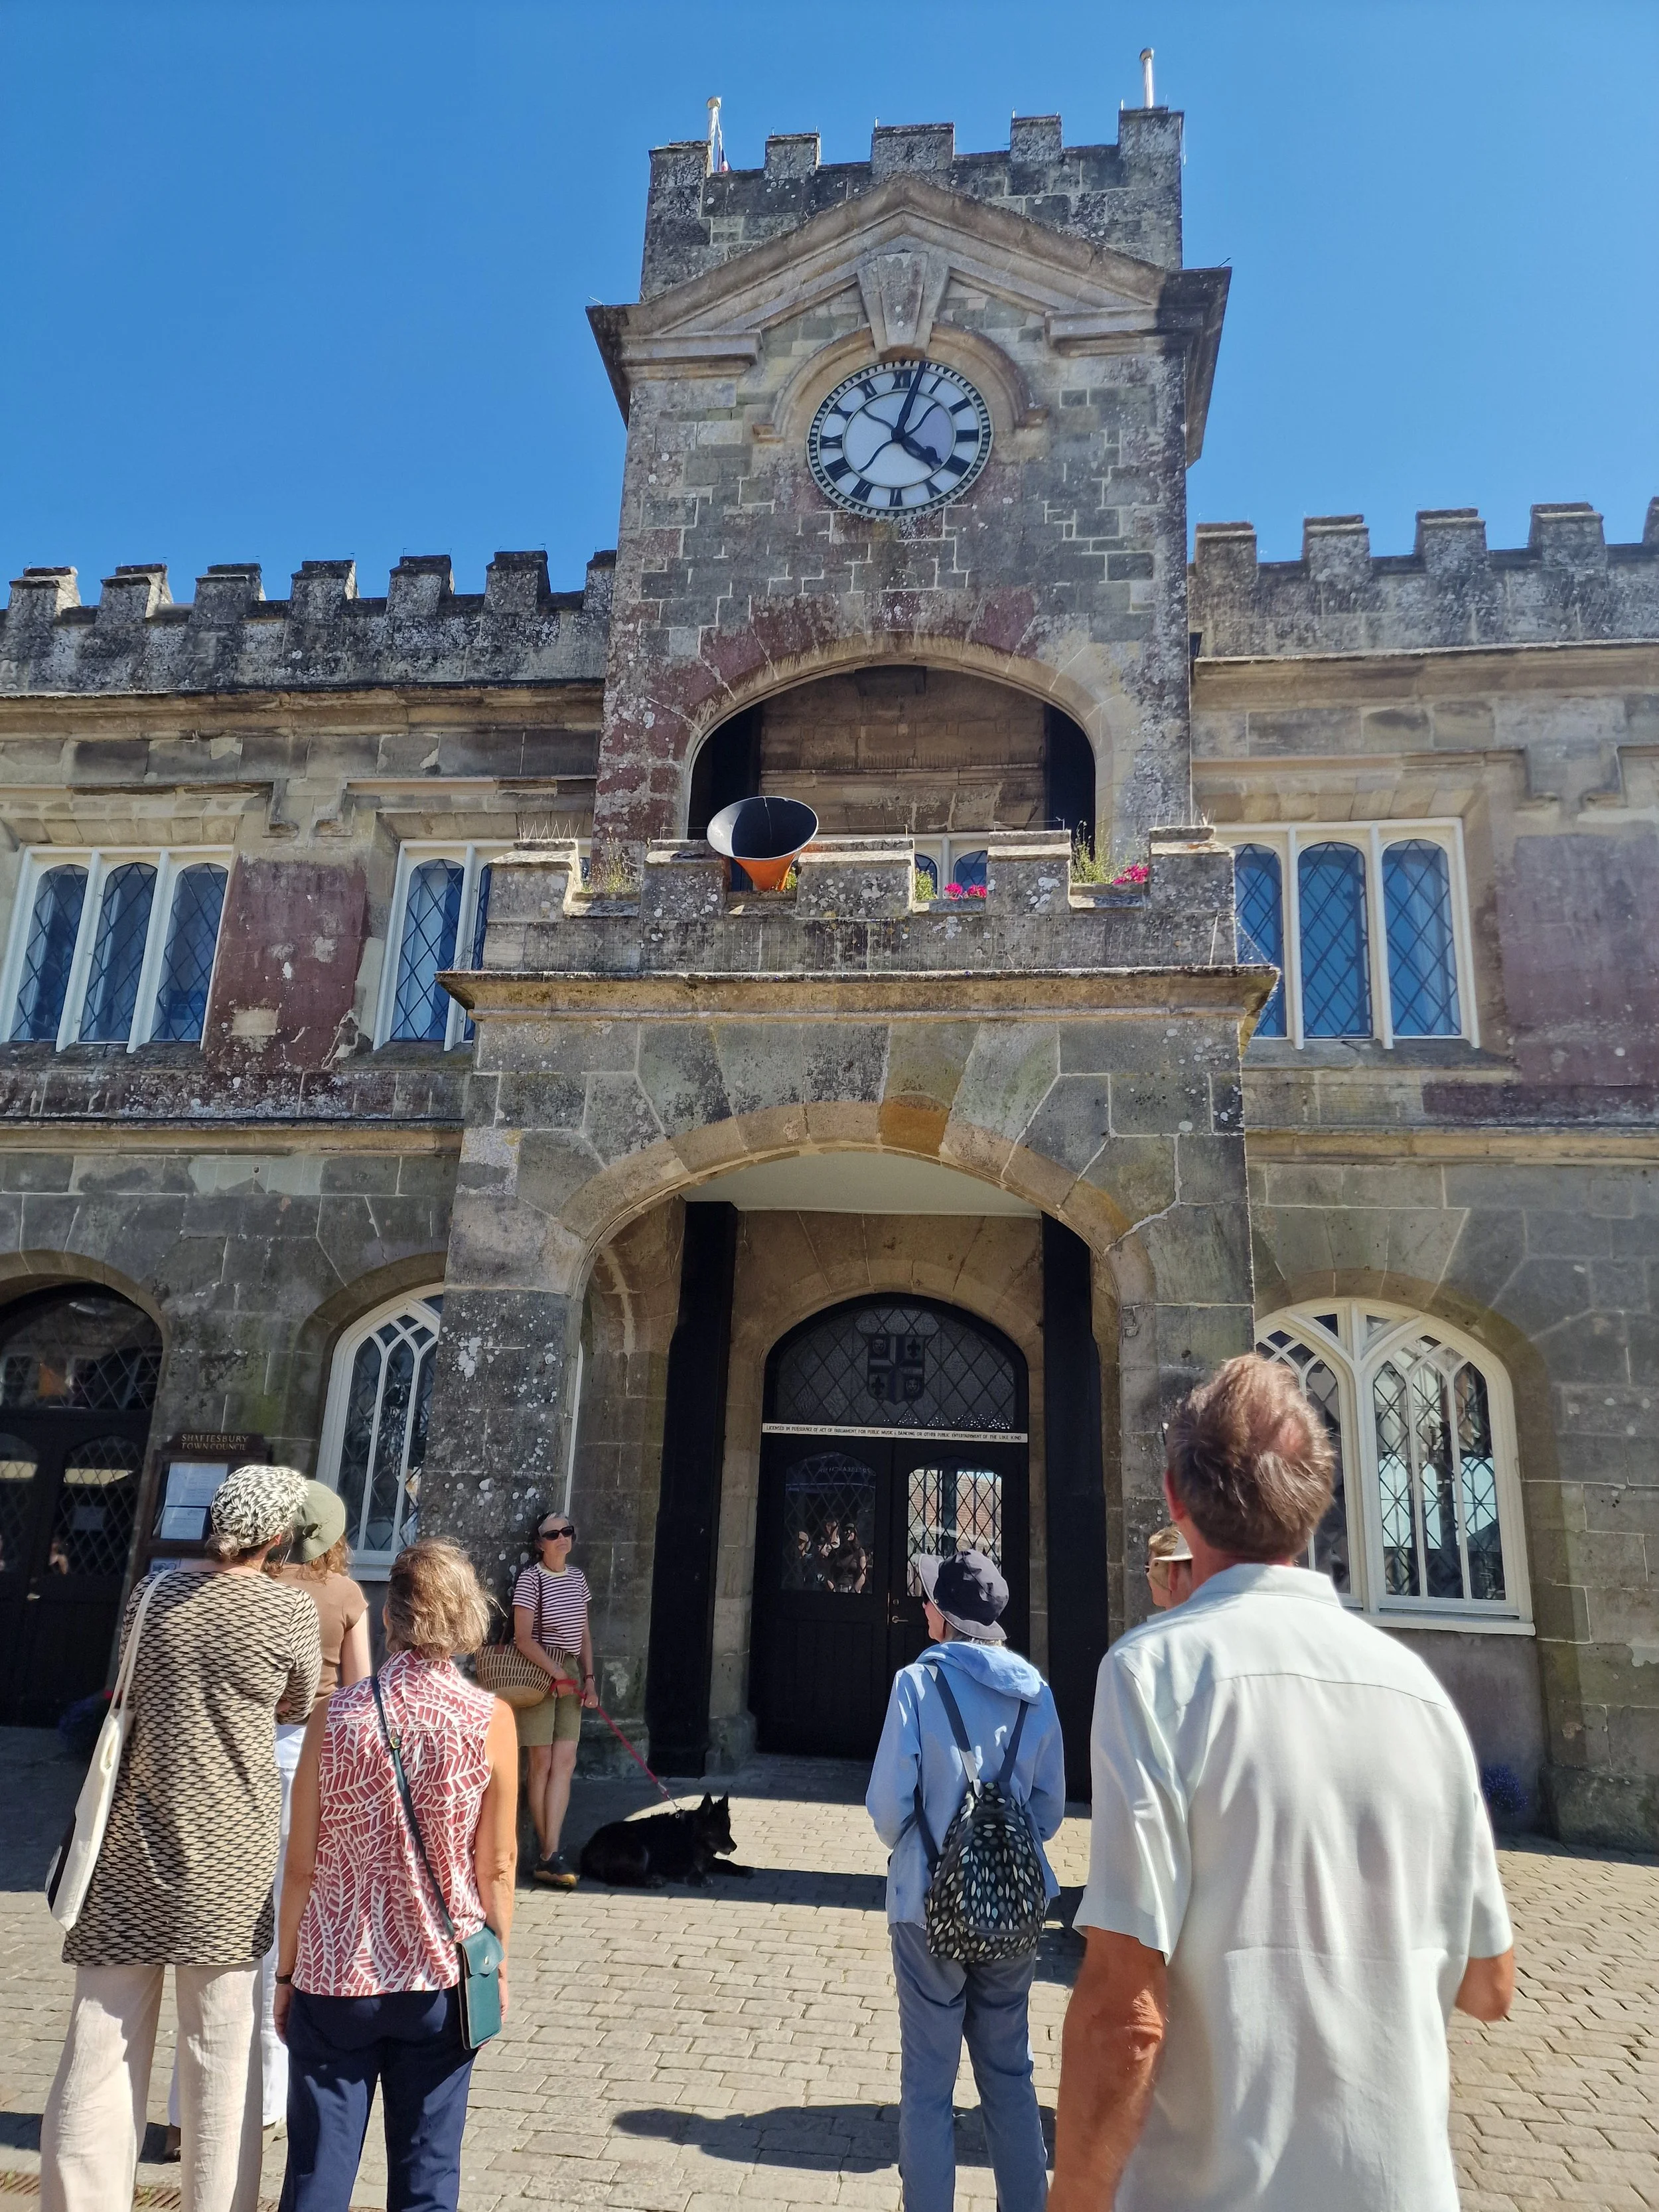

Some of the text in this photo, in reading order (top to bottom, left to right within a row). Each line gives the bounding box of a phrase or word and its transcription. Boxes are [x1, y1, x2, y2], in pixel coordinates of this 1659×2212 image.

[858, 379, 877, 400] XI
[830, 404, 853, 421] X
[820, 435, 843, 449] IX
[849, 479, 873, 503] VII
[889, 487, 902, 506] VI
[925, 479, 942, 498] V
[181, 1434, 249, 1443] SHAFTESBURY
